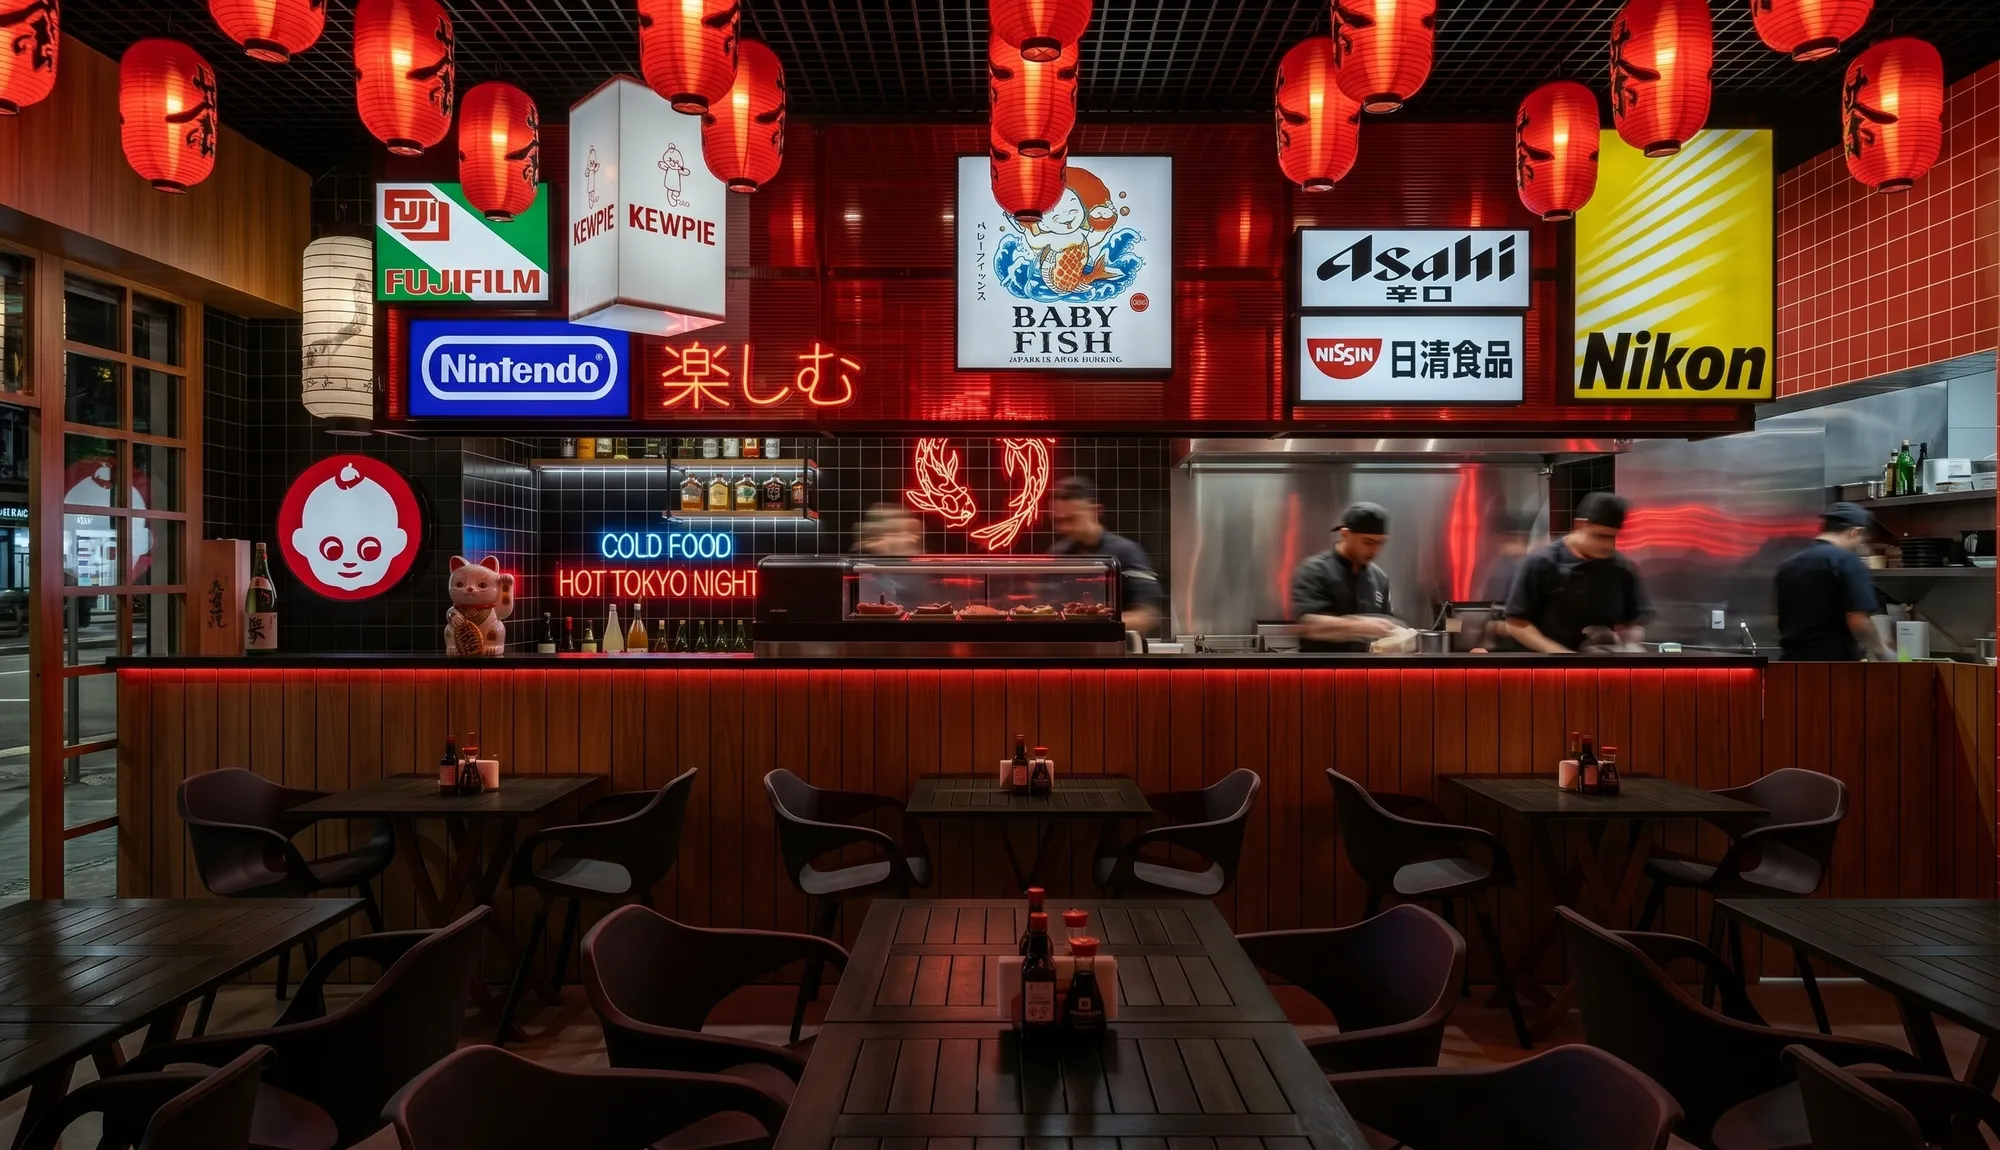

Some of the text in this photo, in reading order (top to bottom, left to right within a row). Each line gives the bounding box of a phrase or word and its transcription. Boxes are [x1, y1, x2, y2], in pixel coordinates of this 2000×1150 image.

[573, 203, 615, 247] KEWPIE
[629, 203, 716, 246] KEWPIE
[1316, 234, 1516, 282] Asahi
[385, 269, 541, 295] FUJIFILM
[1386, 285, 1453, 303] 辛口
[1012, 306, 1118, 328] BABY
[1013, 331, 1113, 355] FISH
[1316, 343, 1373, 366] NISSIN
[1391, 339, 1513, 379] 日清食品
[1578, 330, 1767, 391] Nikon
[661, 341, 861, 409] 楽しむ
[602, 533, 731, 558] COLD FOOD
[559, 569, 758, 597] HOT TOKYO NIGHT
